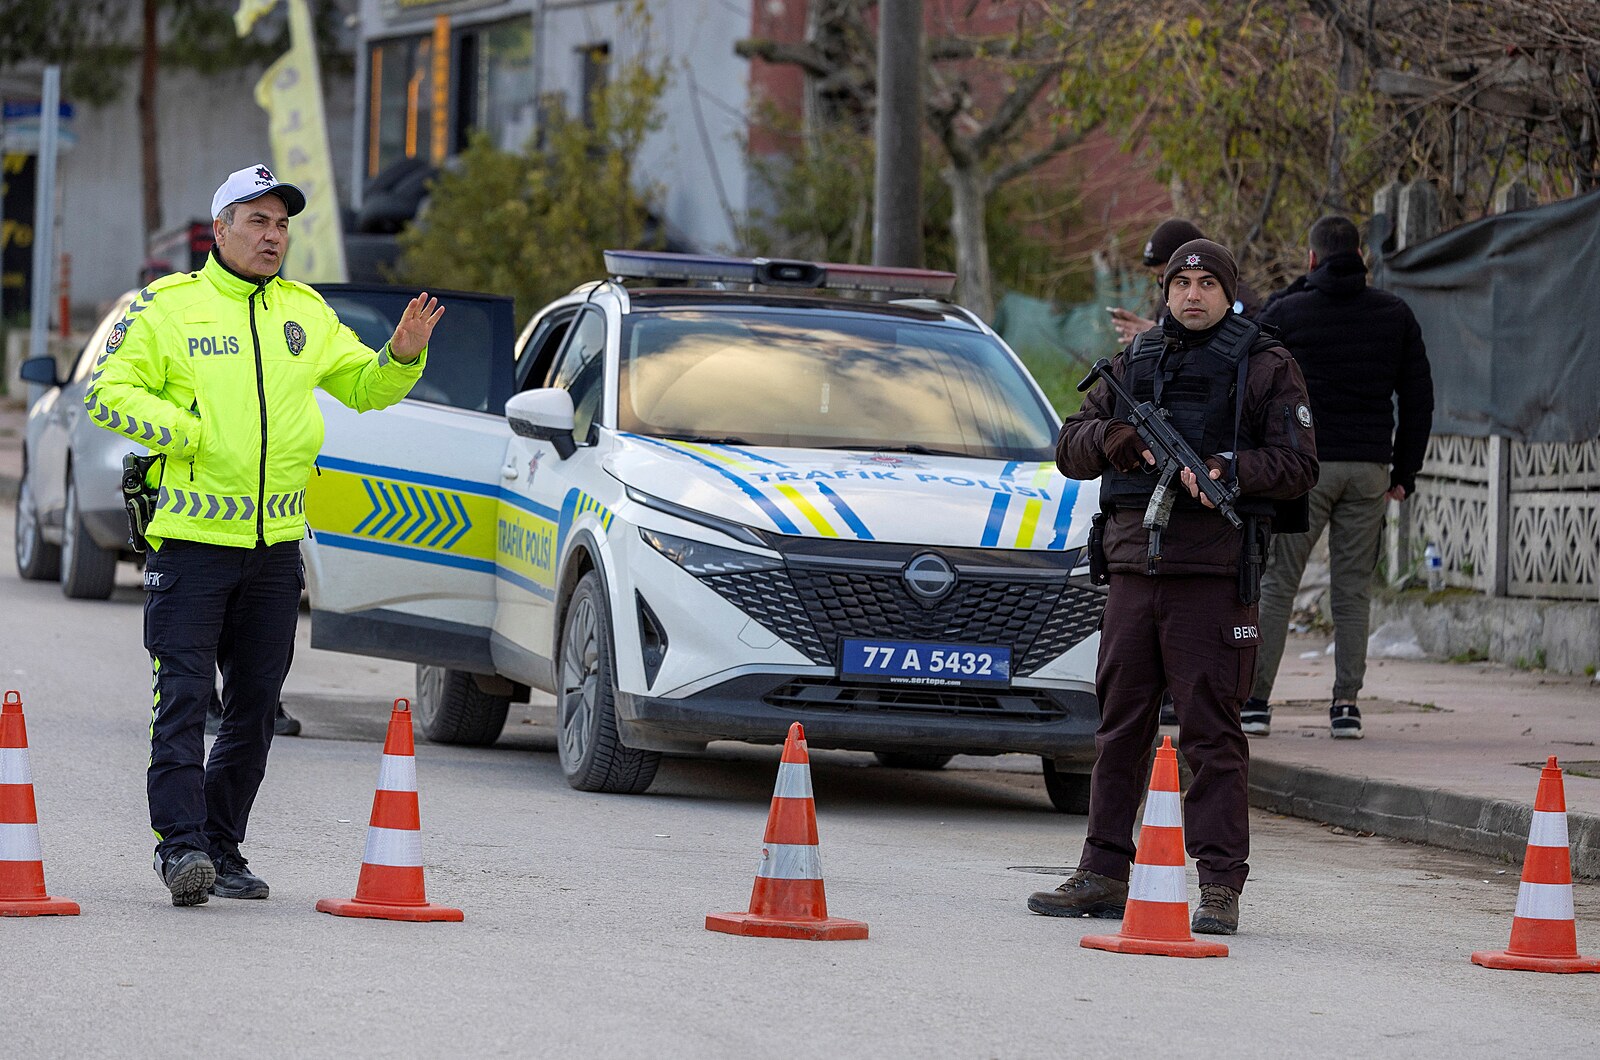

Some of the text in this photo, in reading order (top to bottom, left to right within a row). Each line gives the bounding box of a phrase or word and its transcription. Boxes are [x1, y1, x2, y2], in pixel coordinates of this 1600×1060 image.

[254, 180, 275, 188] POL
[863, 646, 992, 676] 77 A 5432
